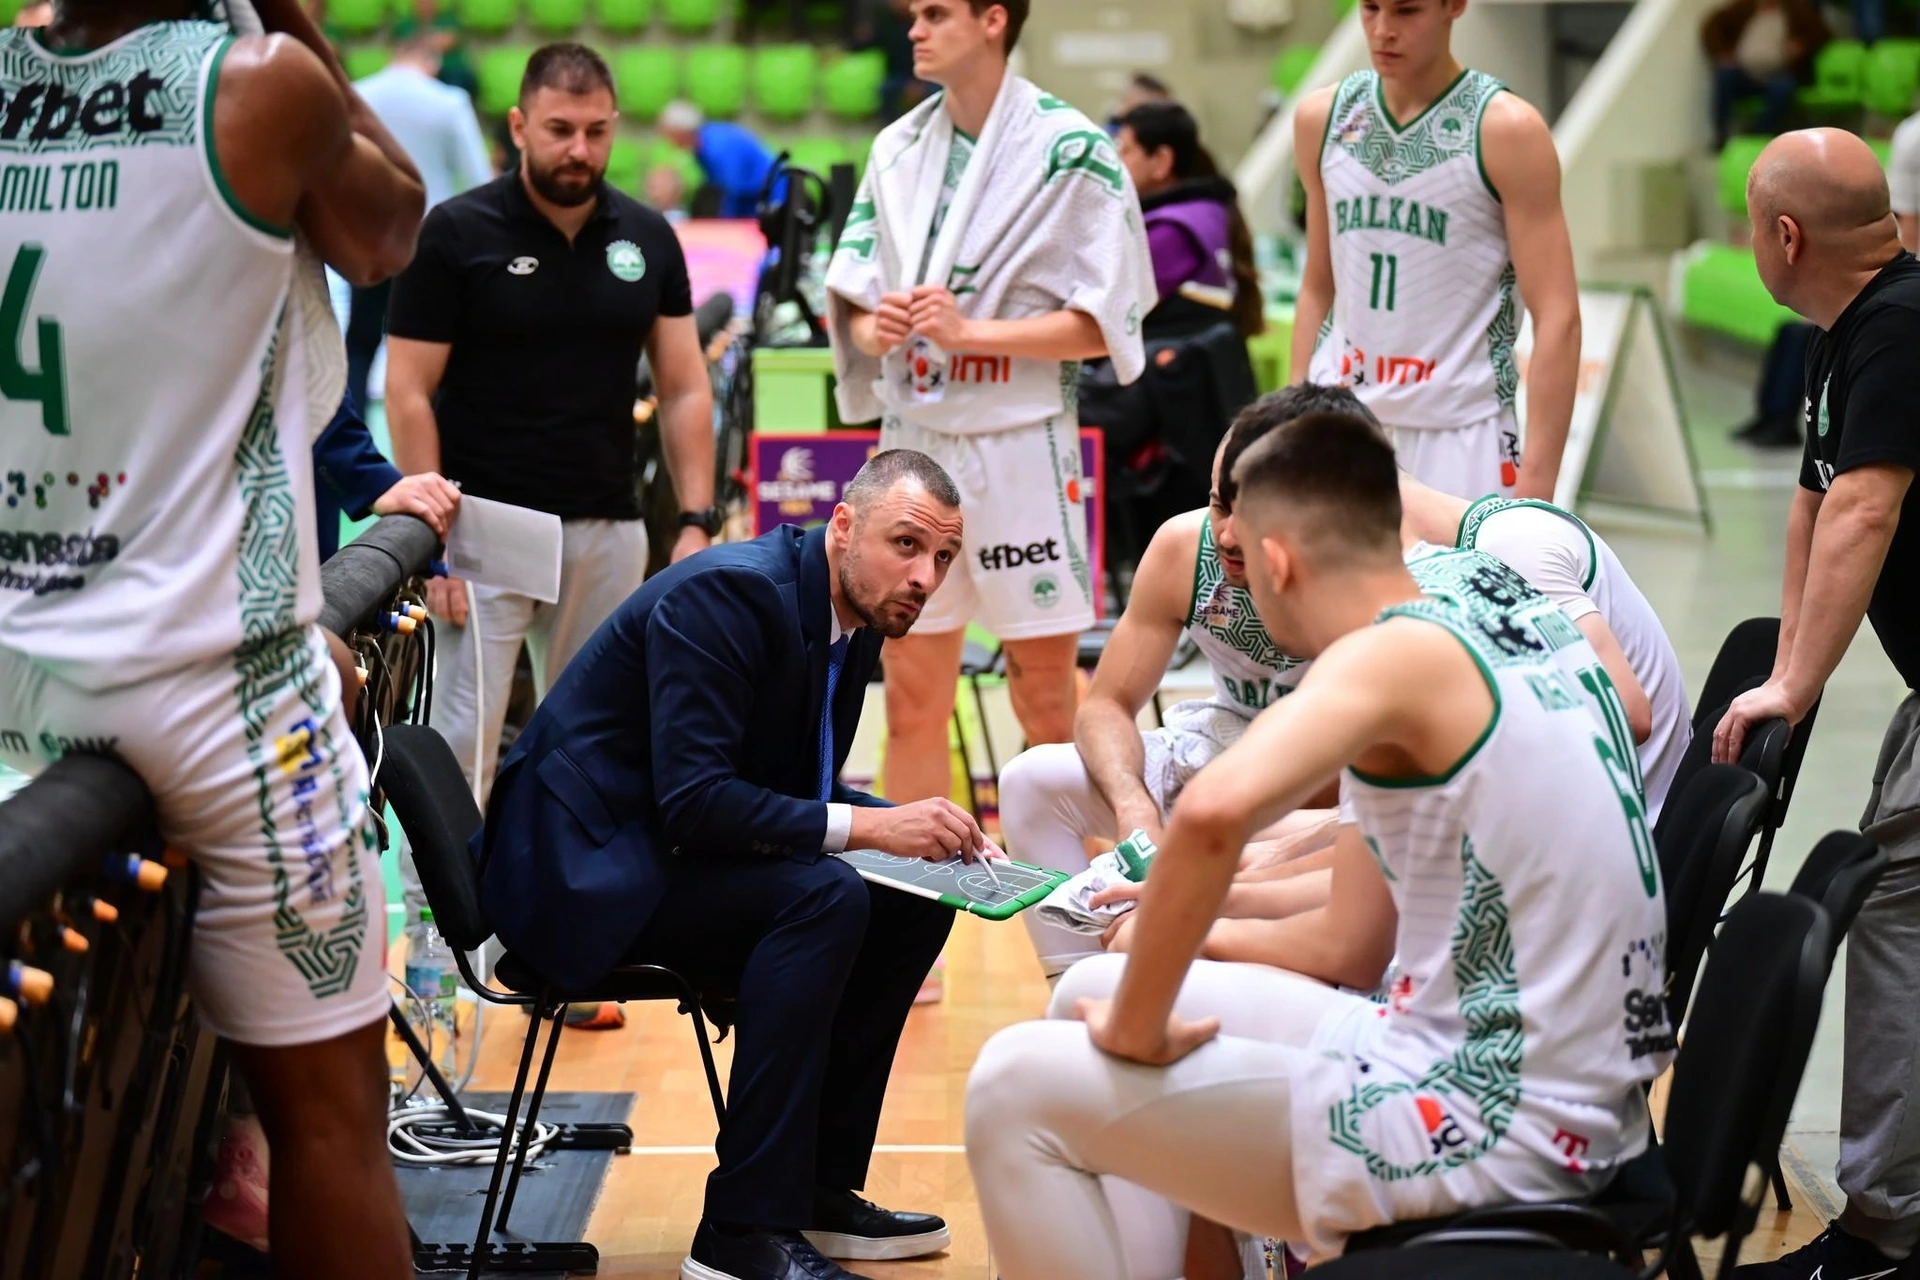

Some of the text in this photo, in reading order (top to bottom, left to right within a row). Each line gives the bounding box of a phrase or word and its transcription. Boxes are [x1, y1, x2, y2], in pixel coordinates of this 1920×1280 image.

[0, 69, 164, 142] fbet
[0, 160, 119, 212] MILTON
[1336, 196, 1449, 246] BALKAN
[1370, 253, 1398, 312] 11
[757, 481, 837, 502] SESAME
[1196, 604, 1240, 619] SESAME
